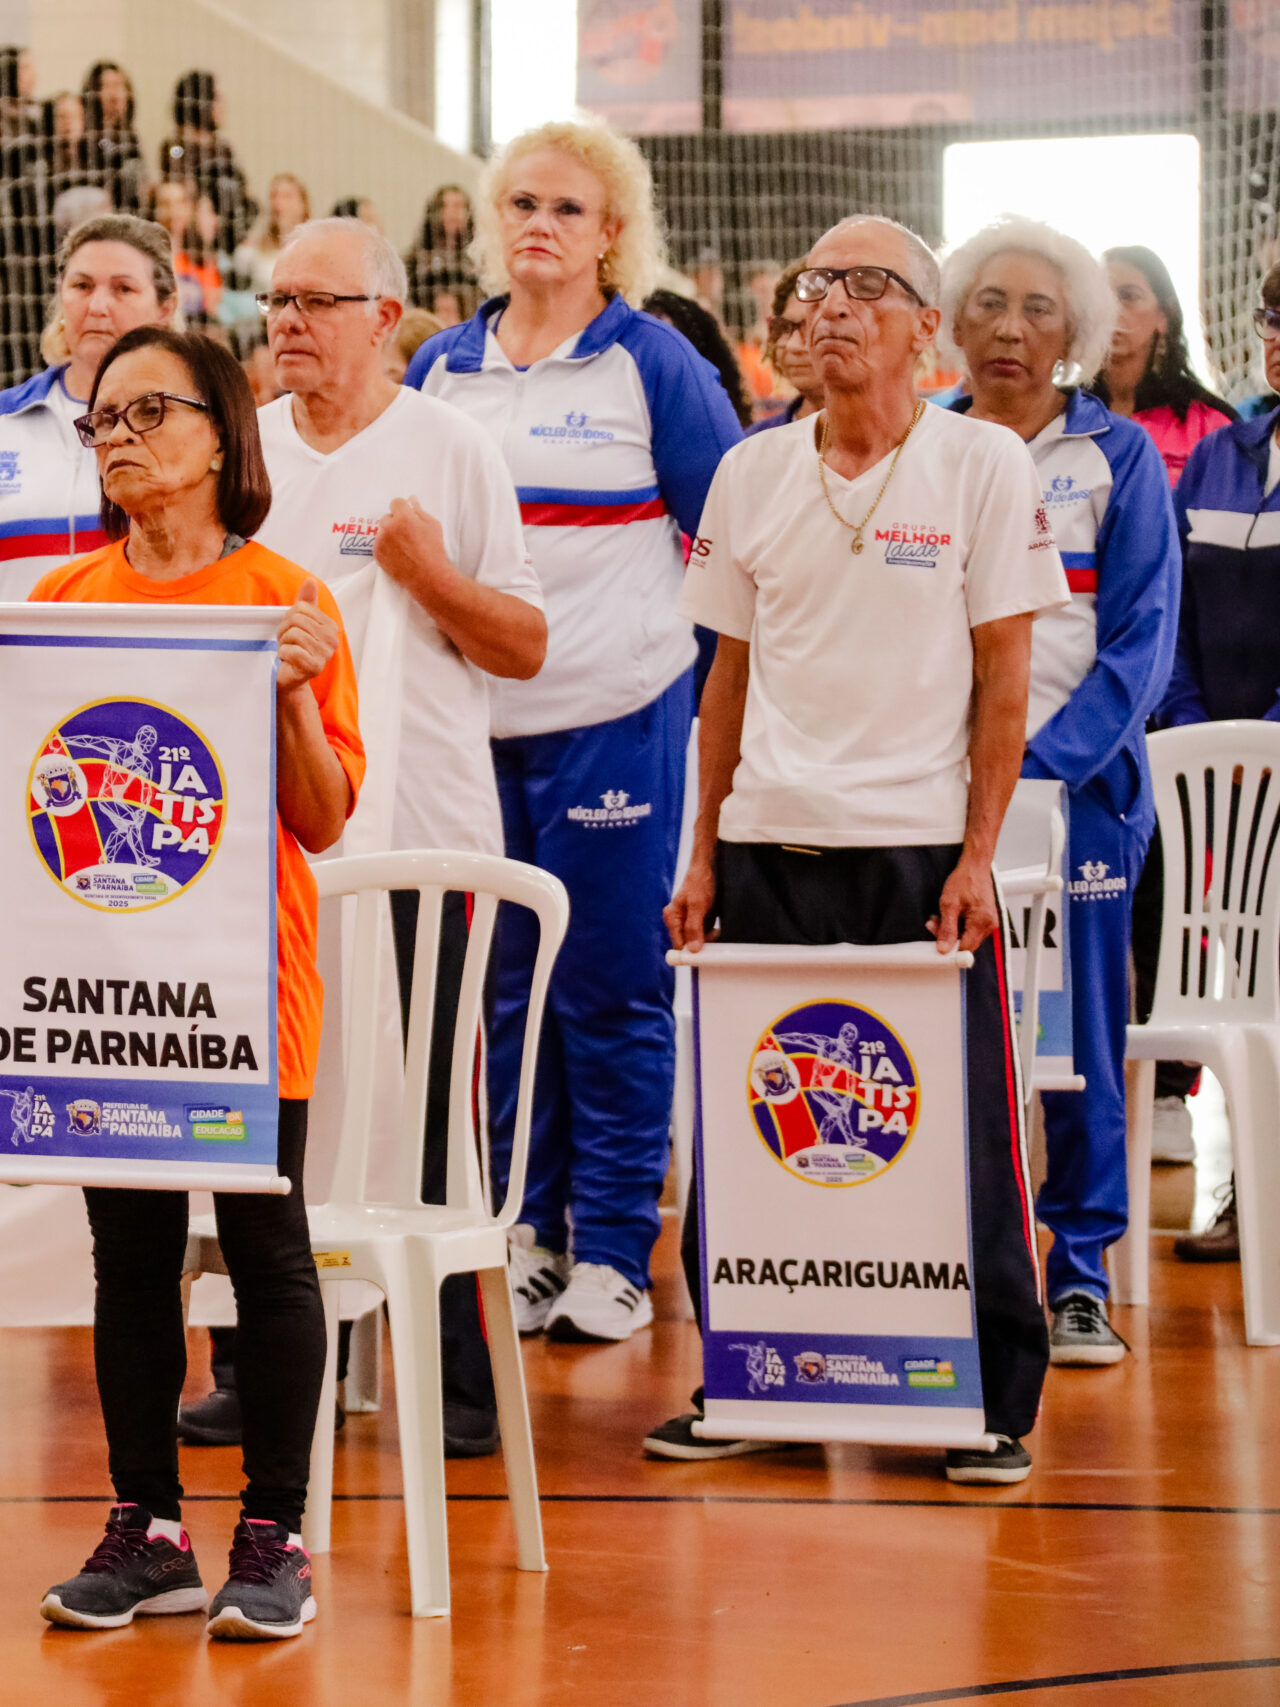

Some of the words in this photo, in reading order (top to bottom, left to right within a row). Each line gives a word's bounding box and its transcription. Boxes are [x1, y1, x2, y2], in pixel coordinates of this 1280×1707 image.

[892, 522, 936, 532] GRUPO
[875, 529, 951, 546] MELHOR
[884, 537, 940, 557] Idade
[158, 746, 191, 762] 21º
[157, 762, 209, 794] JA
[154, 792, 216, 824] TIS
[151, 822, 210, 855] PA
[94, 877, 126, 885] SANTANA
[23, 976, 217, 1018] SANTANA
[47, 1024, 259, 1071] PARNAÍBA
[858, 1055, 903, 1082] JA
[858, 1082, 911, 1109] TIS
[33, 1100, 53, 1113] JA
[190, 1109, 224, 1119] CIDADE
[33, 1112, 56, 1126] TIS
[102, 1109, 166, 1124] SANTANA
[858, 1108, 908, 1135] PA
[31, 1124, 53, 1137] PA
[109, 1121, 182, 1138] PARNAÍBA
[195, 1125, 243, 1136] EDUCAÇÃO
[713, 1257, 971, 1294] ARAÇARIGUAMA
[826, 1360, 885, 1373] SANTANA
[905, 1360, 935, 1369] CIDADE
[765, 1374, 785, 1386] PA
[834, 1371, 900, 1386] PARNAÍBA
